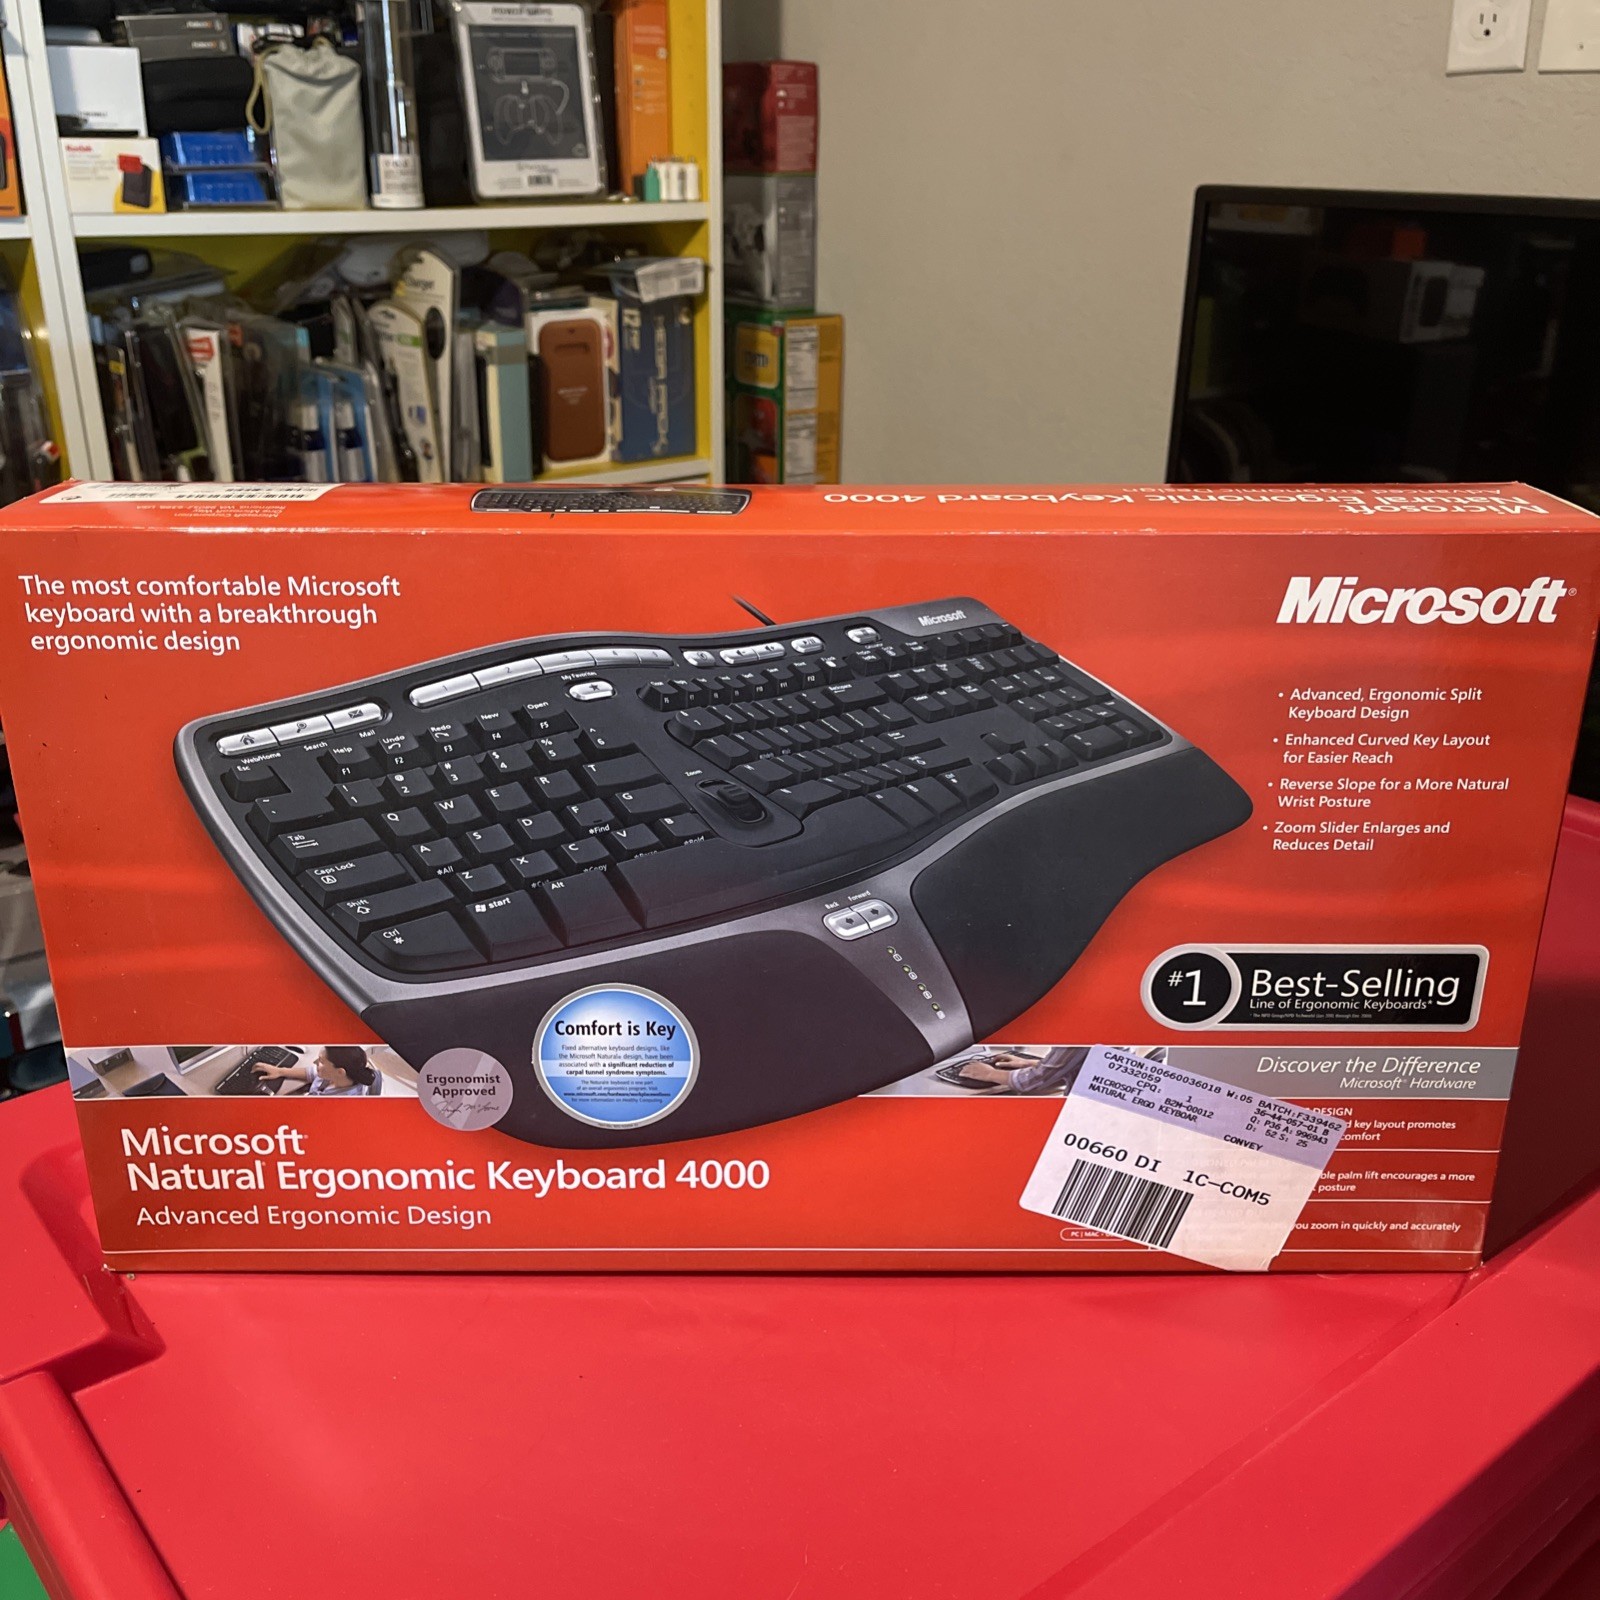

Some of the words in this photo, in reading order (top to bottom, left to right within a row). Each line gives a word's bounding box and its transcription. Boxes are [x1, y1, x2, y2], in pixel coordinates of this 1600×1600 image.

[824, 493, 926, 503] 4000
[937, 493, 1135, 503] Keyboard
[1143, 493, 1369, 505] Ergonomic
[1374, 496, 1531, 505] Natural
[1344, 504, 1550, 515] Microsoft
[18, 575, 65, 595] The
[72, 577, 131, 596] most
[136, 575, 280, 596] comfortable
[288, 575, 400, 596] Microsoft
[25, 603, 134, 628] keyboard
[141, 603, 192, 623] with
[199, 608, 211, 623] a
[218, 603, 376, 629] breakthrough
[918, 609, 967, 627] Microsoft
[30, 630, 158, 655] ergonomic
[164, 630, 240, 656] design
[1290, 688, 1365, 702] Advanced,
[1369, 688, 1446, 703] Ergonomic
[1450, 688, 1482, 703] Split
[527, 701, 549, 710] Open
[480, 712, 499, 720] New
[1289, 706, 1356, 722] Keyboard
[1360, 706, 1409, 722] Design
[359, 730, 376, 738] Mail
[430, 724, 452, 733] Redo
[303, 741, 328, 752] Search
[382, 735, 405, 745] Undo
[1285, 733, 1354, 746] Enhanced
[1358, 733, 1409, 746] Curved
[1413, 734, 1439, 749] Key
[1442, 733, 1490, 748] Layout
[332, 746, 353, 755] Help
[241, 752, 281, 765] Web/Home
[1283, 752, 1303, 765] for
[1307, 752, 1348, 764] Easier
[1352, 752, 1393, 764] Reach
[1280, 778, 1333, 790] Reverse
[1337, 778, 1376, 792] Slope
[1379, 778, 1400, 791] for
[1403, 781, 1412, 790] a
[1415, 779, 1452, 790] More
[1457, 778, 1509, 790] Natural
[1278, 796, 1315, 808] Wrist
[1319, 796, 1371, 808] Posture
[1274, 822, 1316, 834] Zoom
[1319, 822, 1359, 834] Slider
[1362, 822, 1420, 836] Enlarges
[1424, 822, 1450, 834] and
[287, 833, 305, 841] Tab
[1273, 839, 1329, 851] Reduces
[1333, 839, 1374, 851] Detail
[314, 866, 335, 876] Caps
[336, 862, 356, 871] Lock
[551, 881, 565, 890] Alt
[346, 899, 369, 908] Shift
[488, 897, 511, 910] start
[383, 929, 400, 939] Ctrl
[1167, 970, 1206, 1006] #1
[1251, 969, 1460, 1006] Best-Selling
[1250, 998, 1275, 1009] Line
[1278, 998, 1292, 1009] of
[1294, 998, 1361, 1012] Ergonomic
[555, 1020, 622, 1036] Comfort
[628, 1021, 640, 1036] is
[646, 1021, 676, 1040] Key
[1256, 1056, 1341, 1075] Discover
[1344, 1057, 1377, 1074] the
[1381, 1056, 1481, 1076] Difference
[426, 1074, 501, 1086] Ergonomist
[1340, 1077, 1403, 1090] Microsoft
[1409, 1077, 1476, 1090] Hardware
[432, 1086, 496, 1098] Approved
[1088, 1083, 1127, 1101] NATURAL
[1131, 1095, 1155, 1109] ERGO
[1158, 1104, 1198, 1123] KEYBOAR
[1108, 1062, 1161, 1084] 07332059
[1254, 1107, 1318, 1134] 36-44-057-01
[1322, 1128, 1330, 1136] B
[1092, 1075, 1143, 1097] MICROSOFT
[1245, 1123, 1257, 1133] D:
[1265, 1128, 1278, 1139] 52
[1296, 1138, 1308, 1148] 25
[1136, 1080, 1161, 1094] CPQ:
[1186, 1095, 1192, 1103] 1
[1264, 1120, 1282, 1131] P36
[1283, 1125, 1293, 1135] A:
[1295, 1129, 1328, 1146] 996943
[1354, 1121, 1371, 1130] key
[1374, 1120, 1404, 1131] layout
[1407, 1121, 1456, 1131] promotes
[121, 1125, 305, 1156] Microsoft
[1223, 1134, 1263, 1151] CONVEY
[1064, 1133, 1128, 1162] 00660
[1134, 1155, 1162, 1173] DI
[1183, 1170, 1271, 1206] 1C-COM5
[127, 1160, 265, 1191] Natural
[277, 1159, 476, 1198] Ergonomic
[488, 1160, 666, 1198] Keyboard
[676, 1160, 770, 1190] 4000
[1337, 1172, 1362, 1182] palm
[1365, 1171, 1379, 1180] lift
[1381, 1172, 1437, 1182] encourages
[1449, 1173, 1475, 1181] more
[1318, 1184, 1356, 1194] posture
[136, 1205, 259, 1227] Advanced
[268, 1205, 400, 1230] Ergonomic
[408, 1205, 491, 1230] Design
[1311, 1222, 1338, 1230] zoom
[1341, 1221, 1350, 1230] in
[1352, 1221, 1387, 1232] quickly
[1390, 1222, 1408, 1230] and
[1411, 1222, 1461, 1232] accurately
